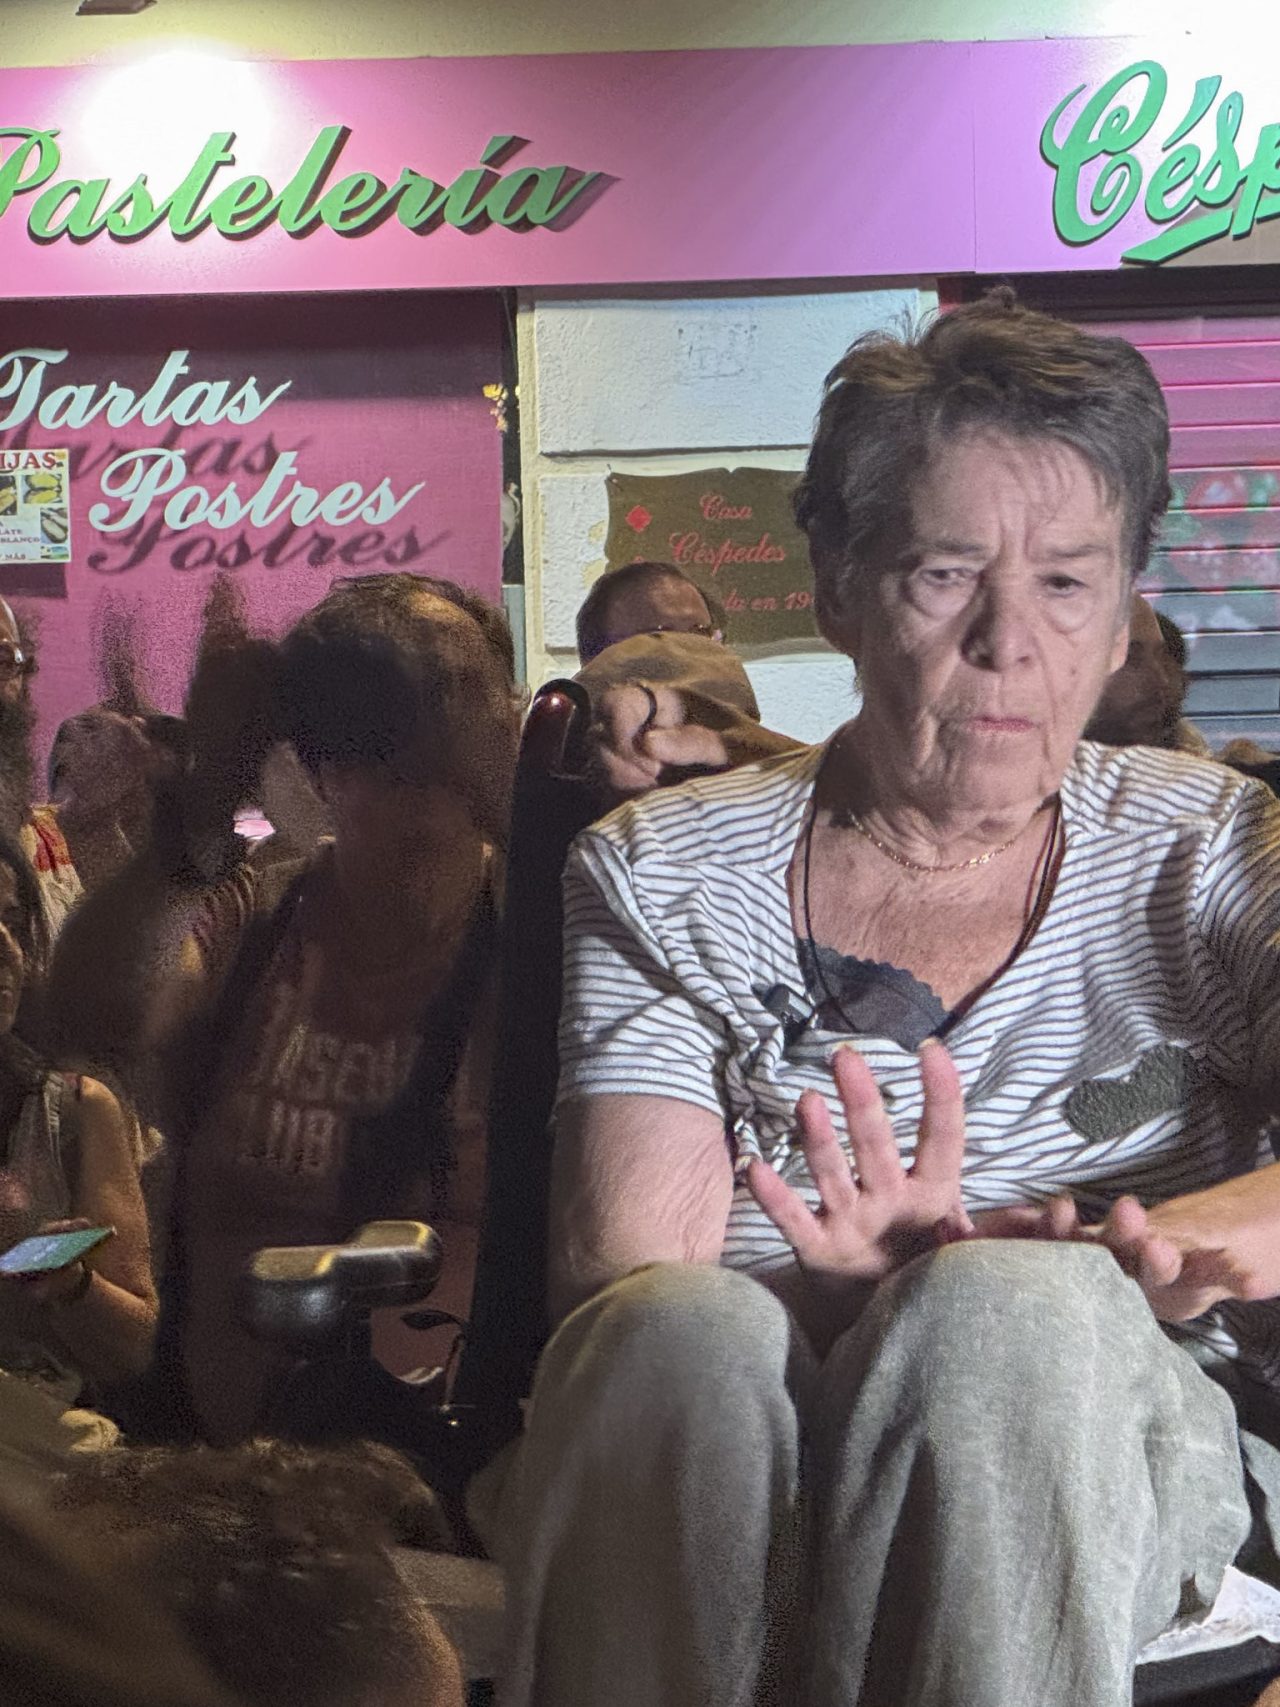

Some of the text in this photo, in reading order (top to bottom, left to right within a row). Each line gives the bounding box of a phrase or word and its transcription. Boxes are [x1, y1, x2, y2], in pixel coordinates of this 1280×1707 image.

[0, 347, 292, 431] Tartas
[88, 447, 426, 532] Postres
[700, 494, 752, 519] Casa
